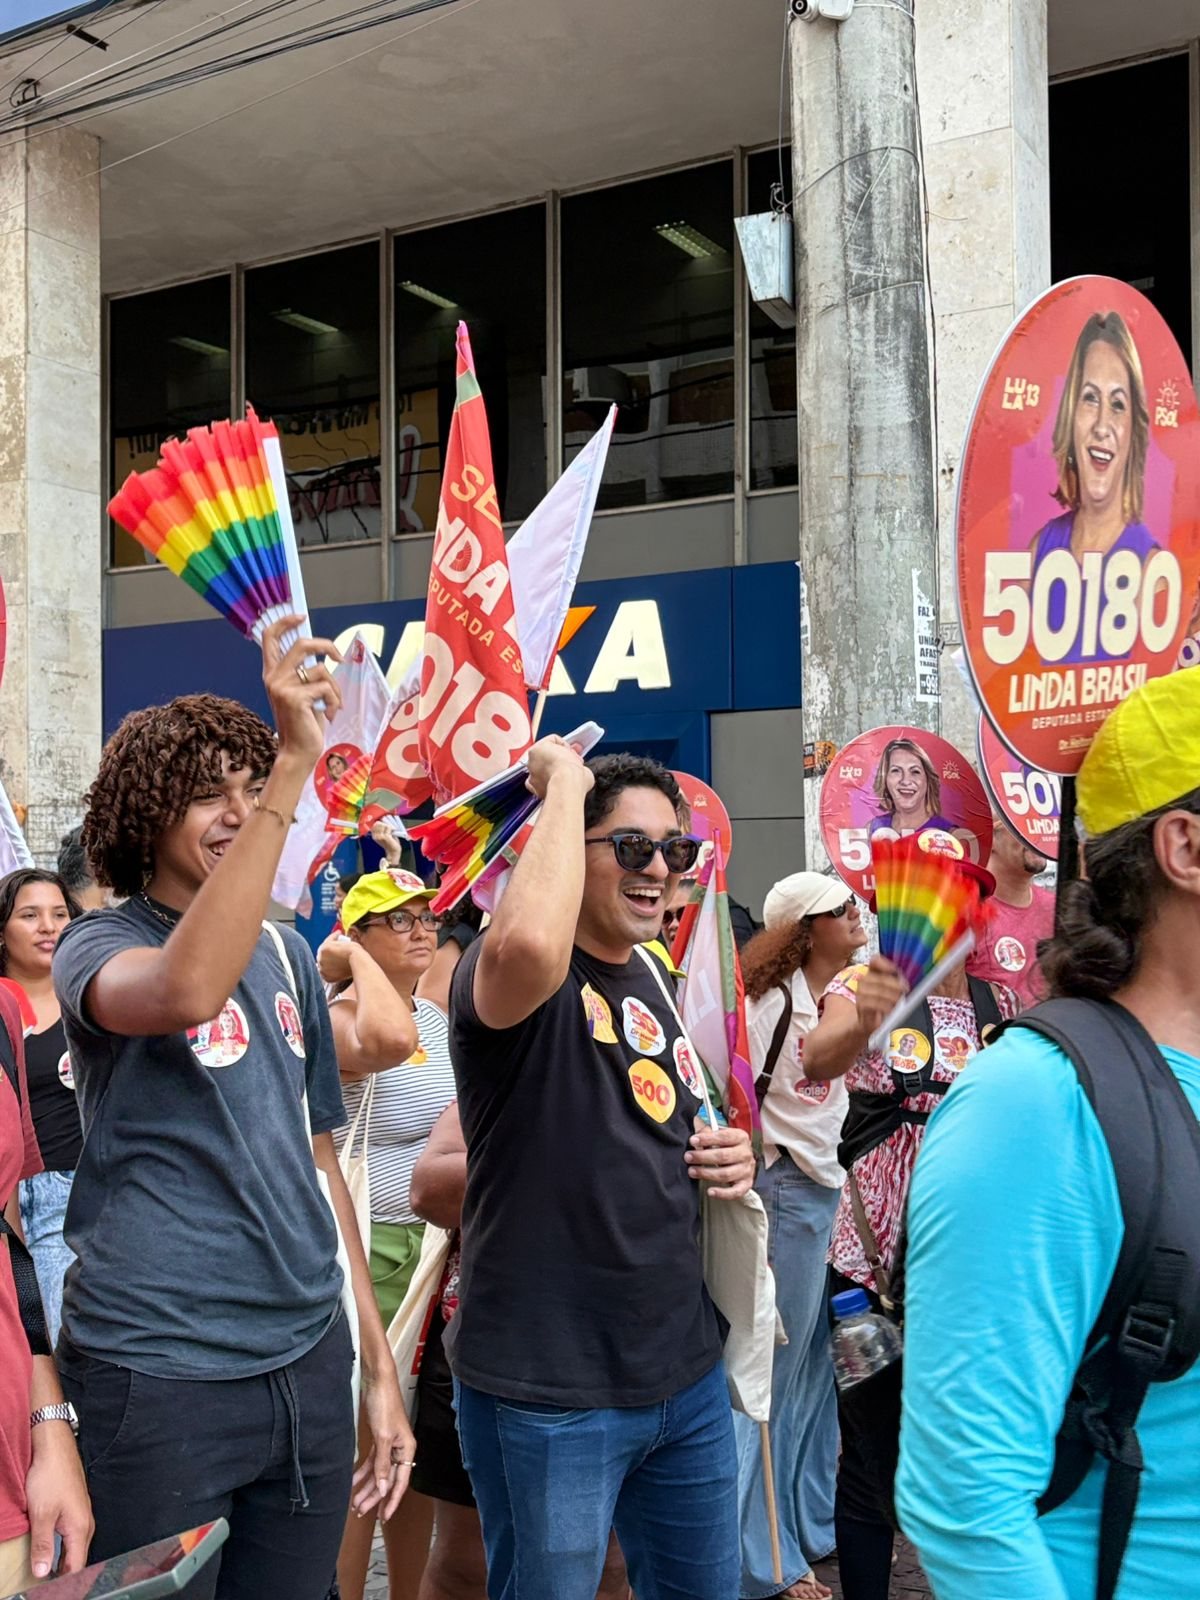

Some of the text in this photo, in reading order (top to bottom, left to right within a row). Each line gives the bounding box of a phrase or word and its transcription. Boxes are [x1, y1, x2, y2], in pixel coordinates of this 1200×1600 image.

[1155, 406, 1178, 428] PSOL
[982, 549, 1182, 665] 50180
[1008, 669, 1077, 713] LINDA
[1032, 713, 1082, 730] DEPUTADA
[936, 1036, 969, 1058] 50
[631, 1074, 672, 1106] 500
[798, 1087, 828, 1096] 50180
